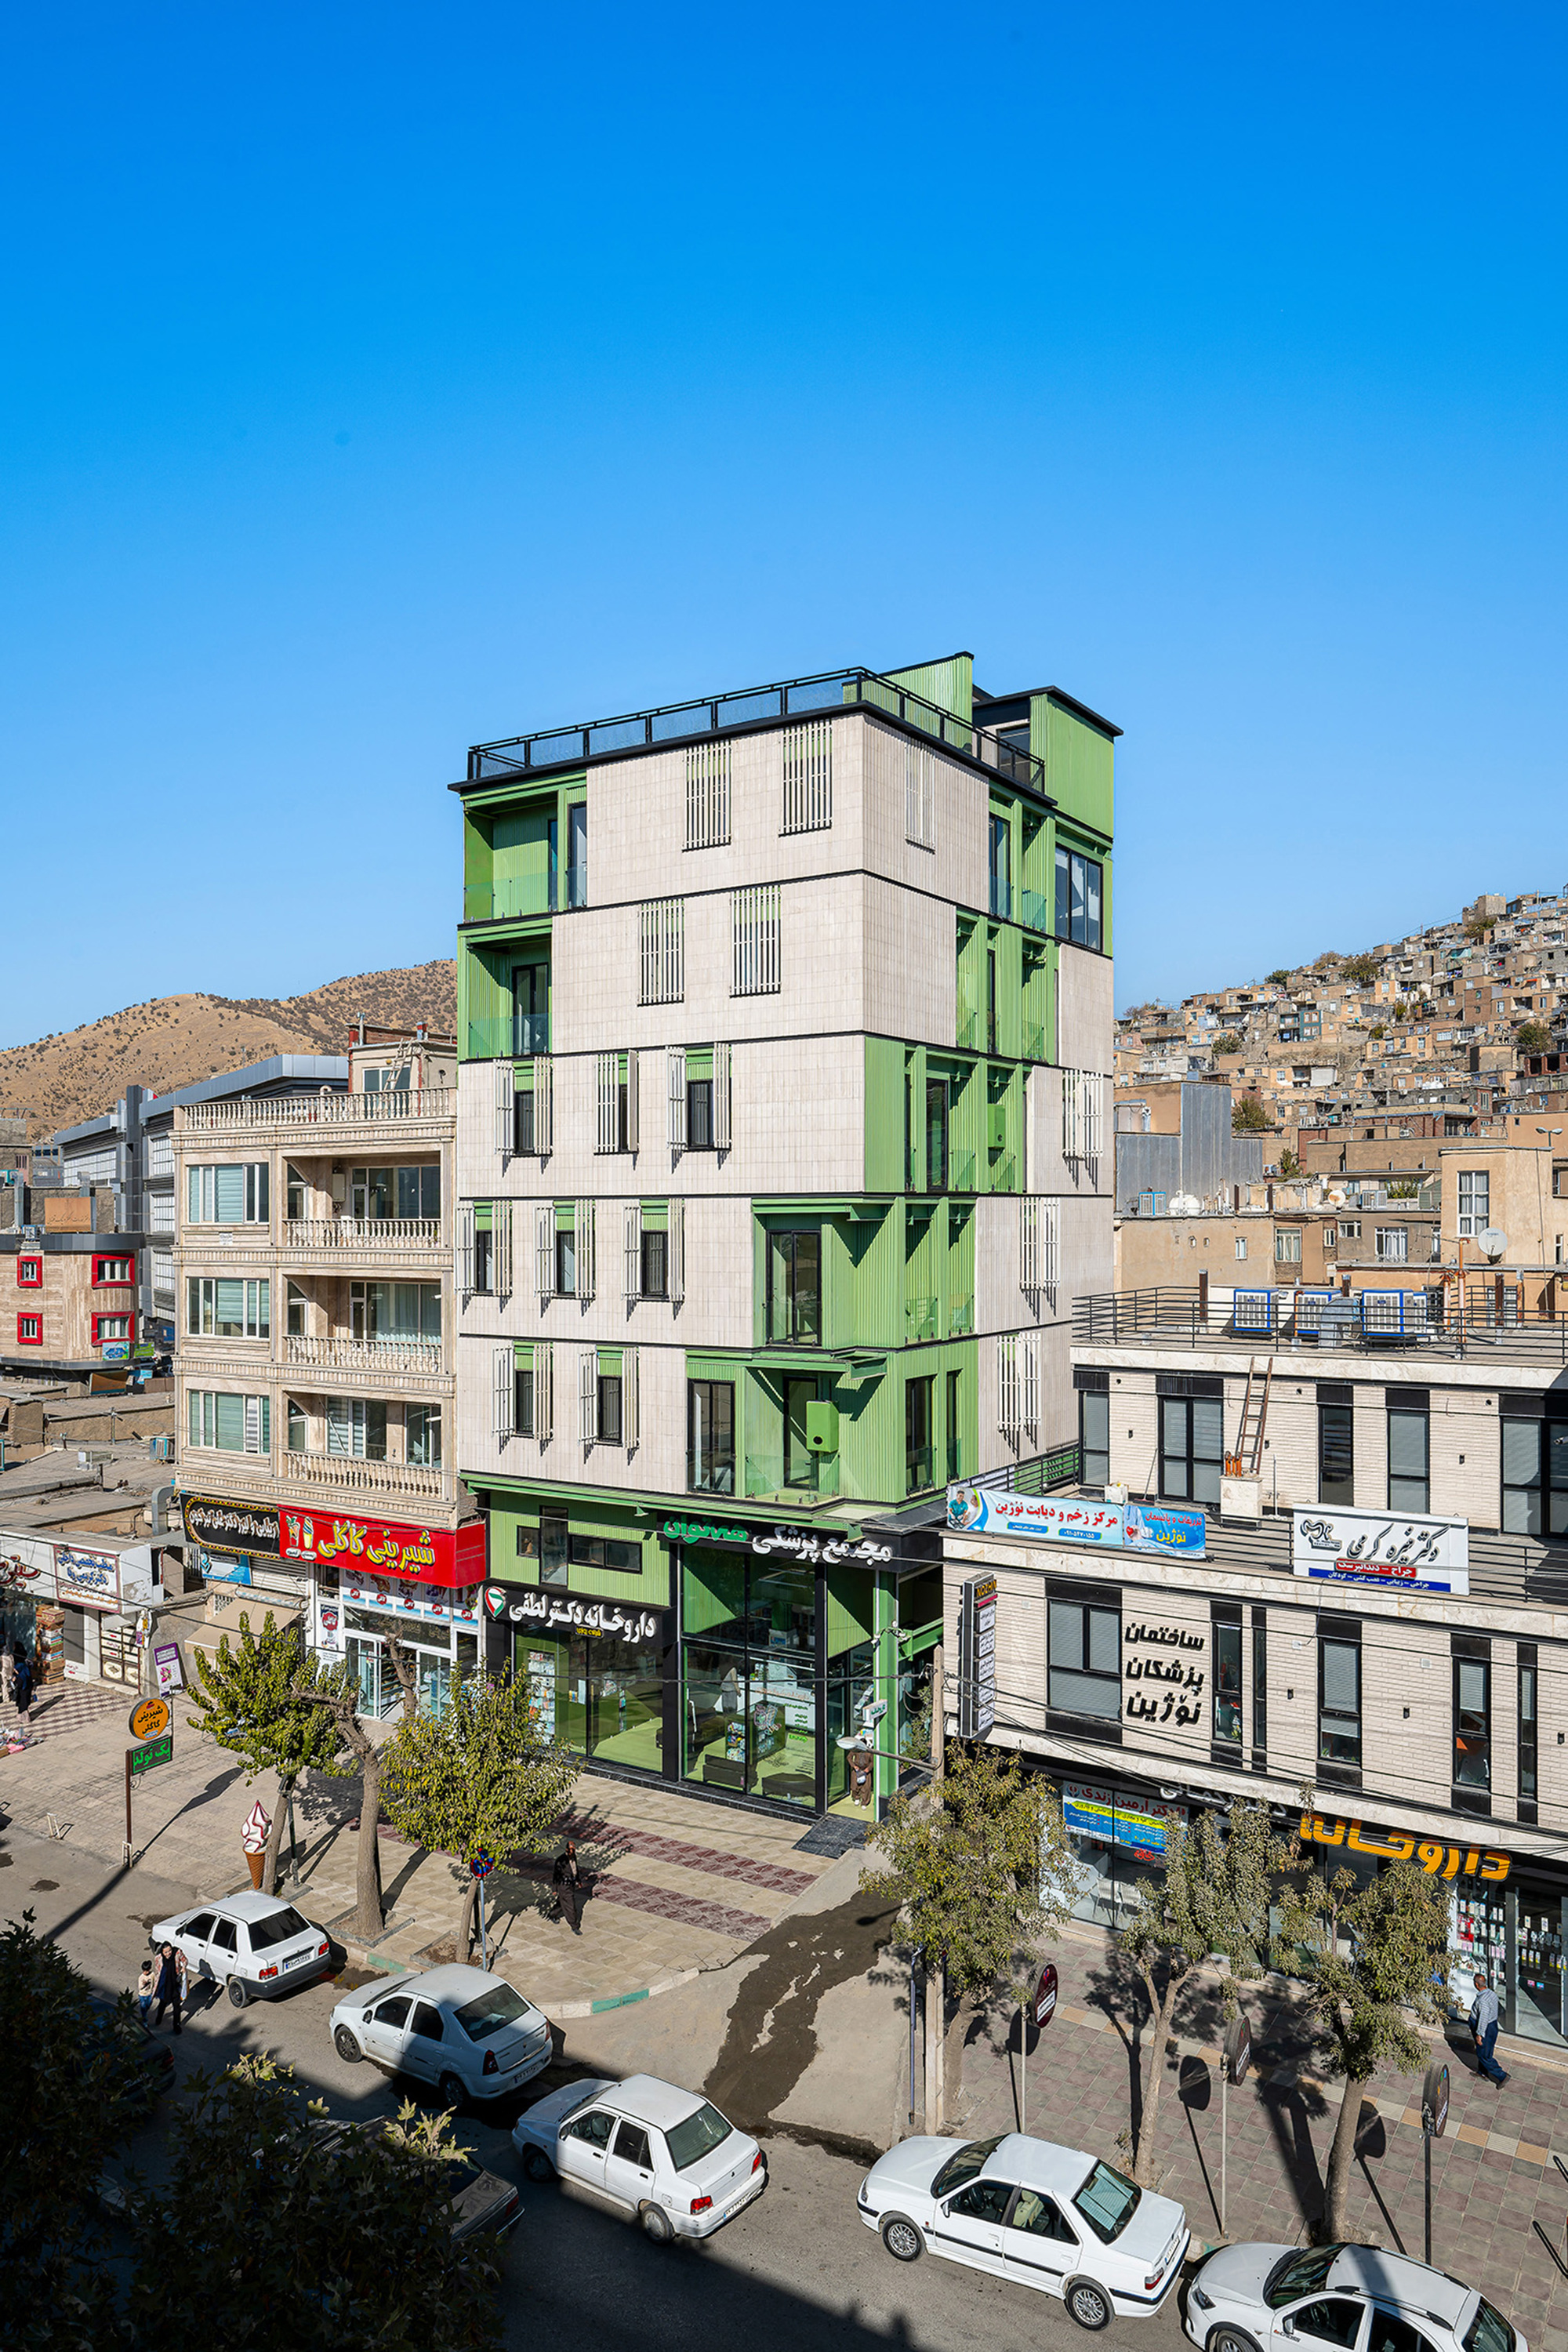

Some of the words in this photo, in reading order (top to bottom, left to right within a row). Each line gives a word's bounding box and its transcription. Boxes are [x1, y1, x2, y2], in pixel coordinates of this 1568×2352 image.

[1026, 1504, 1055, 1519] دیابت
[1058, 1512, 1065, 1522] و
[1067, 1508, 1090, 1525] زخم
[1093, 1511, 1119, 1528] مرکز
[1145, 1511, 1171, 1526] پانسمان
[1178, 1515, 1203, 1527] تزریقات
[365, 1529, 437, 1574] شیرینی
[752, 1526, 821, 1563] پزشکی
[822, 1537, 893, 1566] مجتمع
[1411, 1523, 1451, 1566] دکتر
[1391, 1566, 1413, 1577] جراح
[509, 1592, 548, 1622] لطفی
[545, 1600, 585, 1628] دکتر
[584, 1604, 658, 1643] داروخانه
[1124, 1622, 1206, 1651] ساختمان
[1126, 1657, 1205, 1697] پزشکان
[137, 1705, 163, 1723] شیرینی
[1081, 1788, 1112, 1806] زندی
[1115, 1797, 1149, 1813] آرمین
